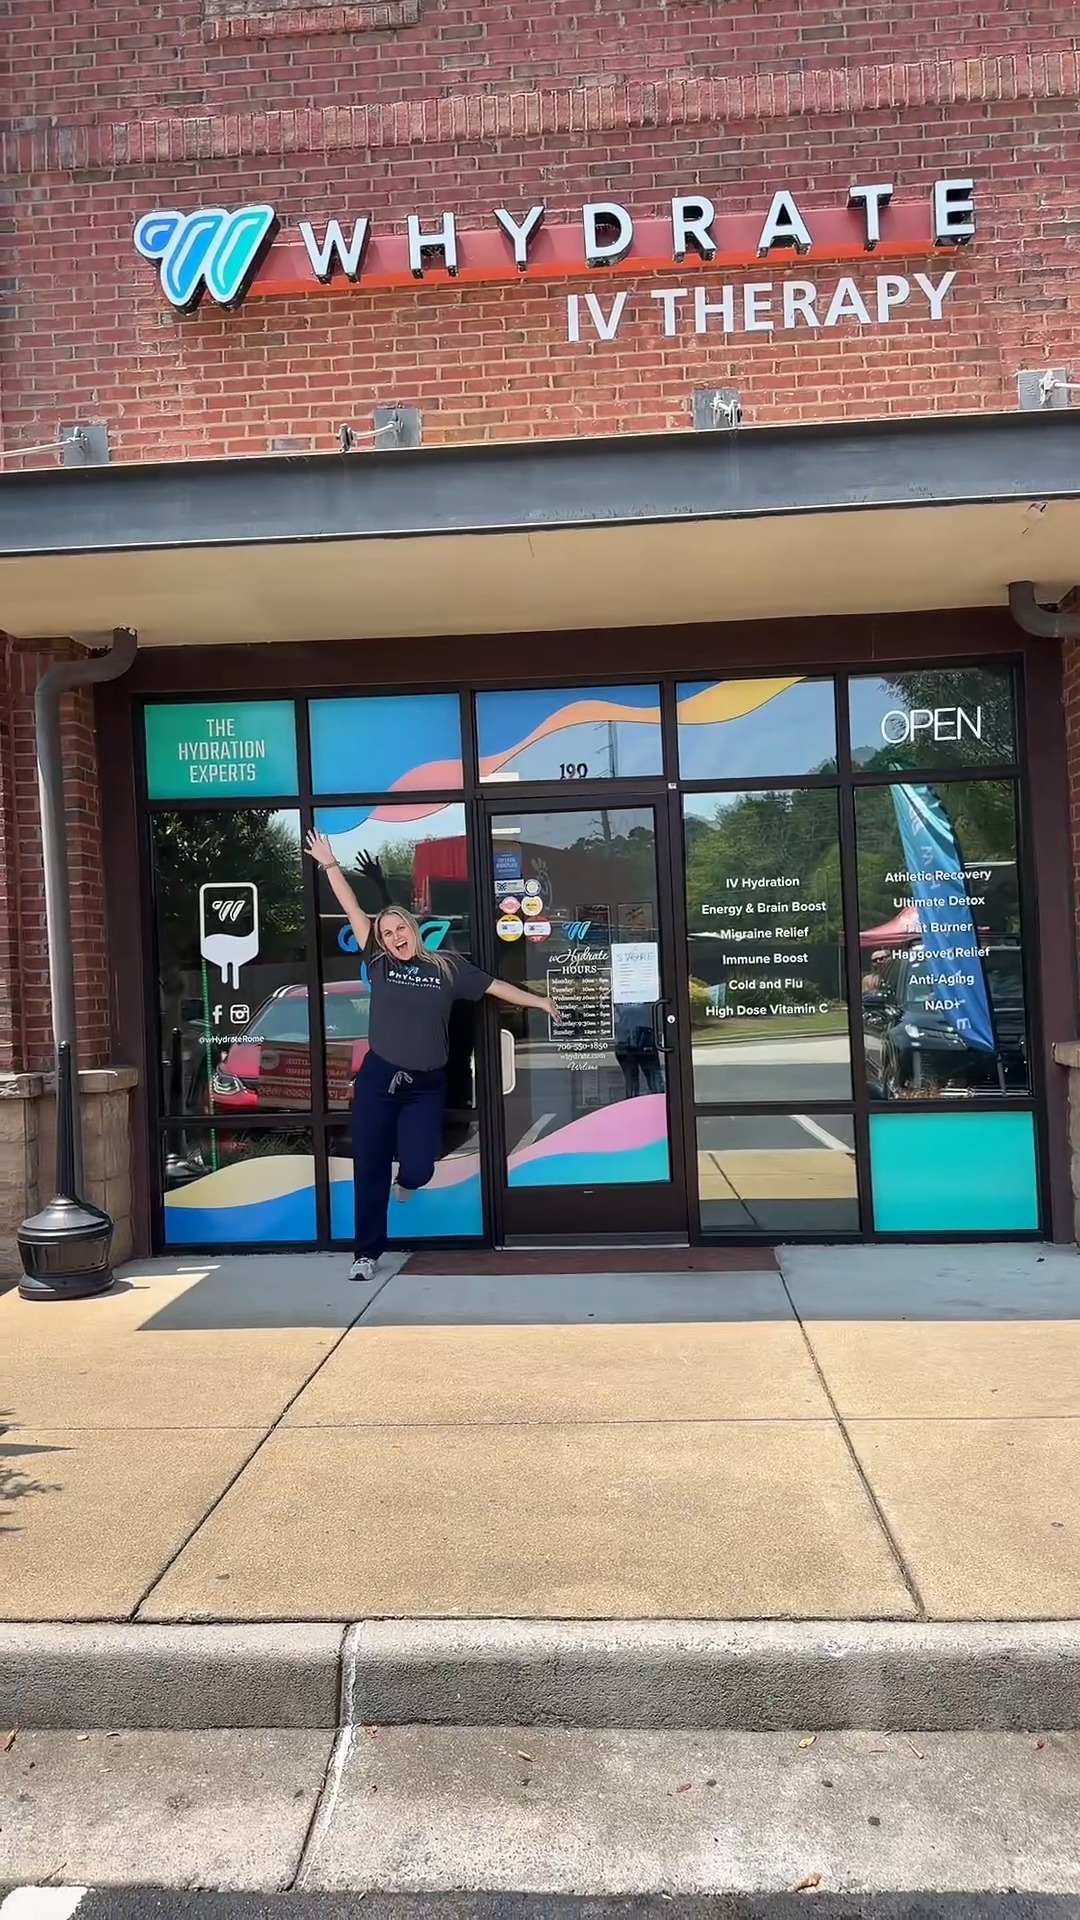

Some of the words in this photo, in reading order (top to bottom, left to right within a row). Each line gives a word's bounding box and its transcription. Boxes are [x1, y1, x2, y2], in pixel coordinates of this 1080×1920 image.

[299, 179, 975, 285] WHYDRATE
[567, 291, 628, 342] IV
[650, 271, 958, 337] THERAPY
[206, 718, 235, 737] THE
[881, 706, 982, 744] OPEN
[178, 740, 265, 761] HYDRATION
[190, 763, 256, 783] EXPERTS
[560, 763, 588, 779] 190
[726, 878, 738, 888] IV
[742, 876, 800, 890] Hydration
[885, 871, 932, 883] Athletic
[935, 870, 992, 881] Recovery
[702, 904, 743, 916] Energy
[745, 903, 755, 914] &
[757, 902, 789, 913] Brain
[792, 901, 827, 912] Boost
[893, 898, 945, 908] Ultimate
[949, 896, 985, 906] Detox
[720, 928, 772, 941] Migraine
[775, 926, 809, 938] Relief
[930, 922, 973, 933] Burner
[955, 946, 990, 957] Relief
[722, 954, 771, 965] Immune
[774, 953, 808, 964] Boost
[562, 965, 597, 974] HOURS
[728, 980, 756, 990] Cold
[759, 979, 782, 989] and
[785, 978, 803, 989] Flu
[908, 974, 975, 987] Anti-Aging
[705, 1006, 734, 1018] High
[737, 1005, 767, 1016] Dose
[769, 1003, 816, 1014] Vitamin
[819, 1003, 829, 1013] C
[925, 1000, 961, 1011] NAD+
[199, 1035, 265, 1045] @wHydrateRome
